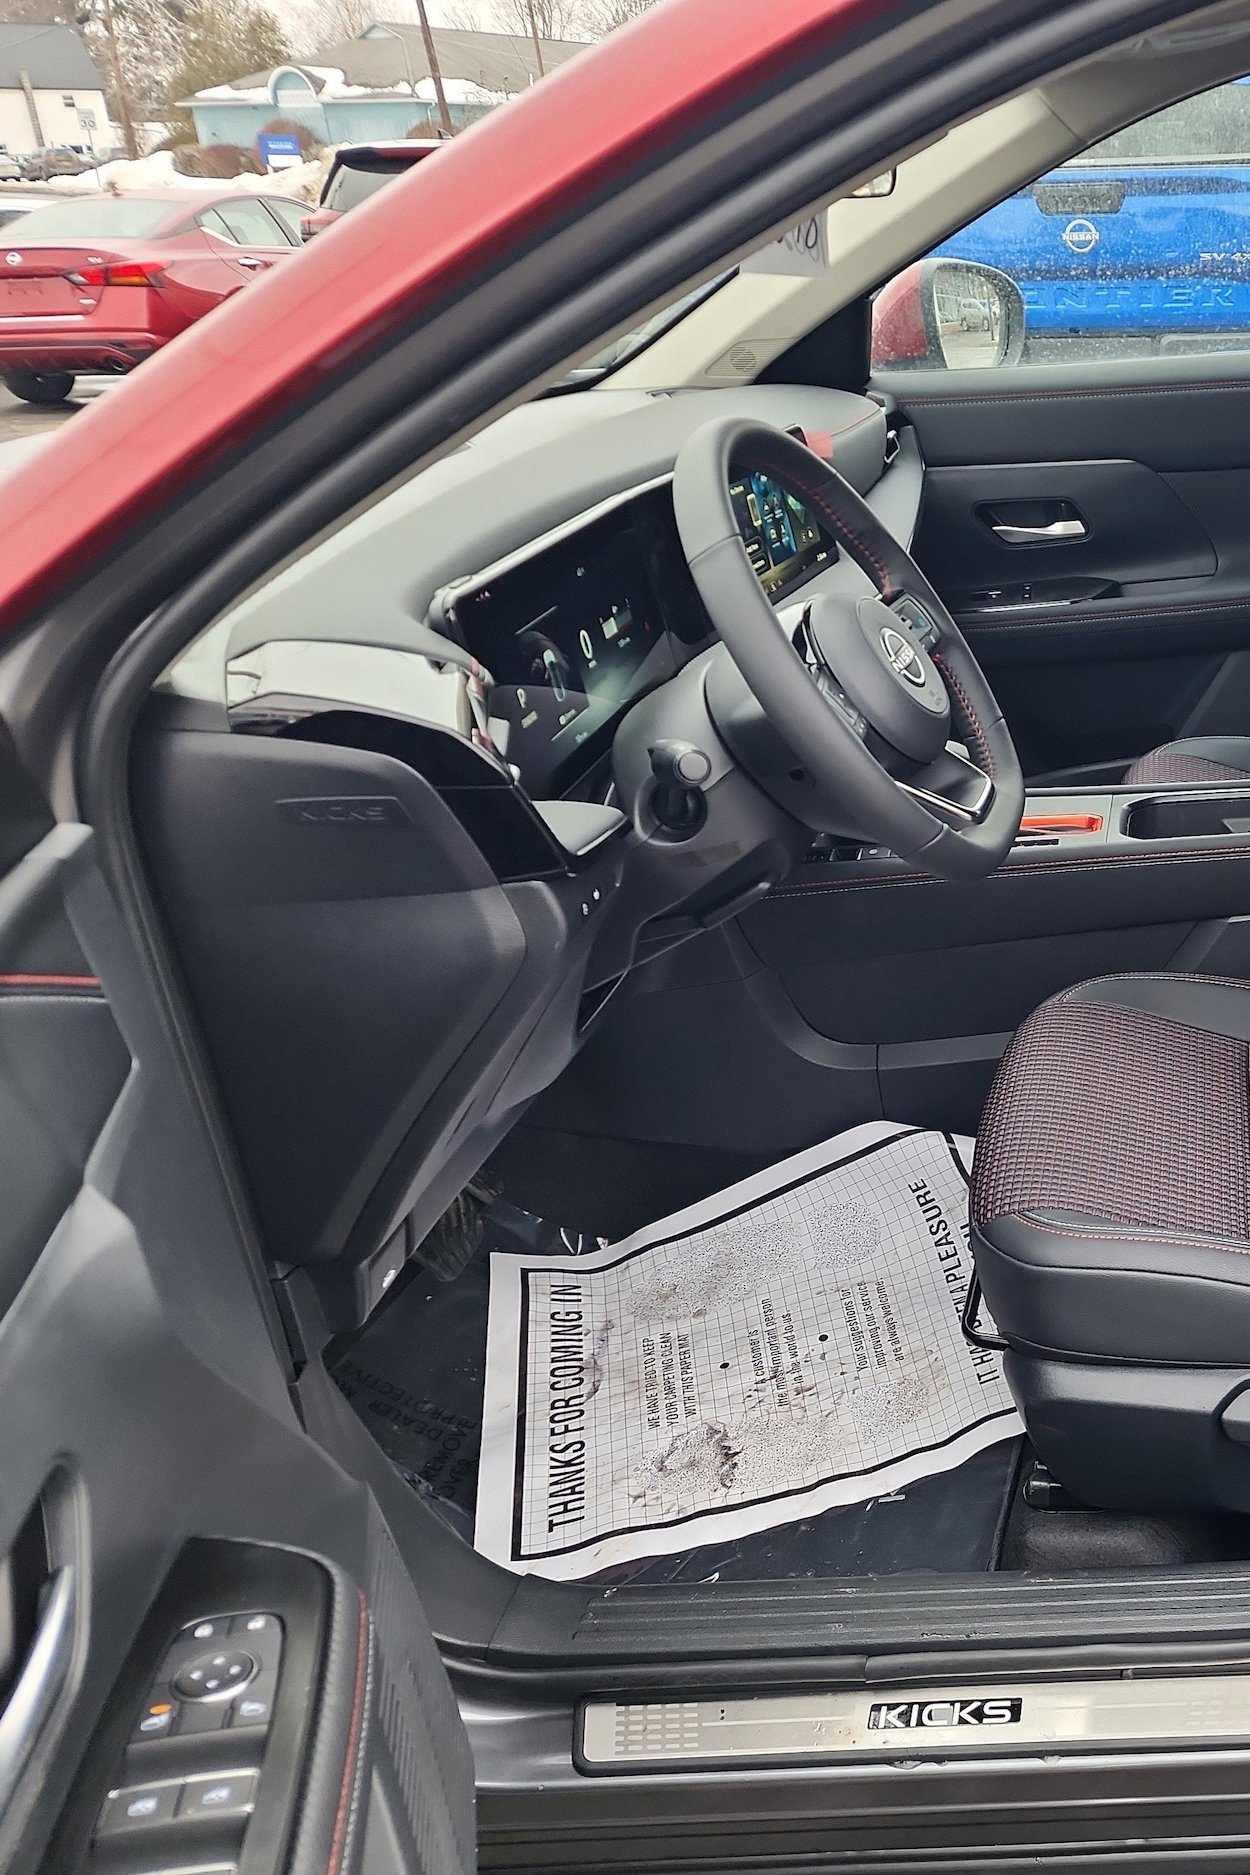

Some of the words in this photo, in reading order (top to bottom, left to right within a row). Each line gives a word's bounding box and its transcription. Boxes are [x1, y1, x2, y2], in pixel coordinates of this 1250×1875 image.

[1062, 231, 1100, 241] NISSAN
[1200, 252, 1226, 261] SV
[300, 806, 385, 820] KICKS
[908, 1178, 966, 1284] PLEASURE
[550, 1284, 582, 1303] IN
[841, 1288, 852, 1301] for
[857, 1281, 873, 1312] service
[875, 1277, 893, 1318] welcome.
[949, 1283, 968, 1295] A
[761, 1298, 777, 1327] person
[865, 1312, 876, 1327] our
[747, 1329, 759, 1338] is
[782, 1324, 794, 1335] to
[844, 1300, 864, 1352] suggestions
[885, 1317, 901, 1347] always
[549, 1310, 585, 1391] COMING
[642, 1337, 655, 1357] KEEP
[659, 1332, 673, 1357] CLEAN
[677, 1333, 690, 1350] MAT
[764, 1327, 782, 1370] important
[783, 1334, 799, 1360] world
[868, 1326, 887, 1370] improving
[644, 1357, 656, 1370] TO
[679, 1349, 693, 1376] PAPER
[750, 1338, 765, 1377] customer
[856, 1352, 869, 1372] Your
[892, 1346, 905, 1362] are
[662, 1357, 676, 1400] CARPETING
[790, 1361, 802, 1375] the
[976, 1368, 1000, 1385] IT
[644, 1369, 657, 1392] TRIED
[681, 1376, 695, 1395] THIS
[774, 1369, 787, 1391] most
[792, 1375, 804, 1386] in
[646, 1392, 660, 1415] HAVE
[683, 1395, 697, 1418] WITH
[777, 1392, 789, 1407] the
[549, 1394, 585, 1438] FOR
[647, 1415, 661, 1430] WE
[665, 1400, 679, 1427] YOUR
[548, 1439, 585, 1532] THANKS
[877, 1700, 1012, 1729] KICKS
